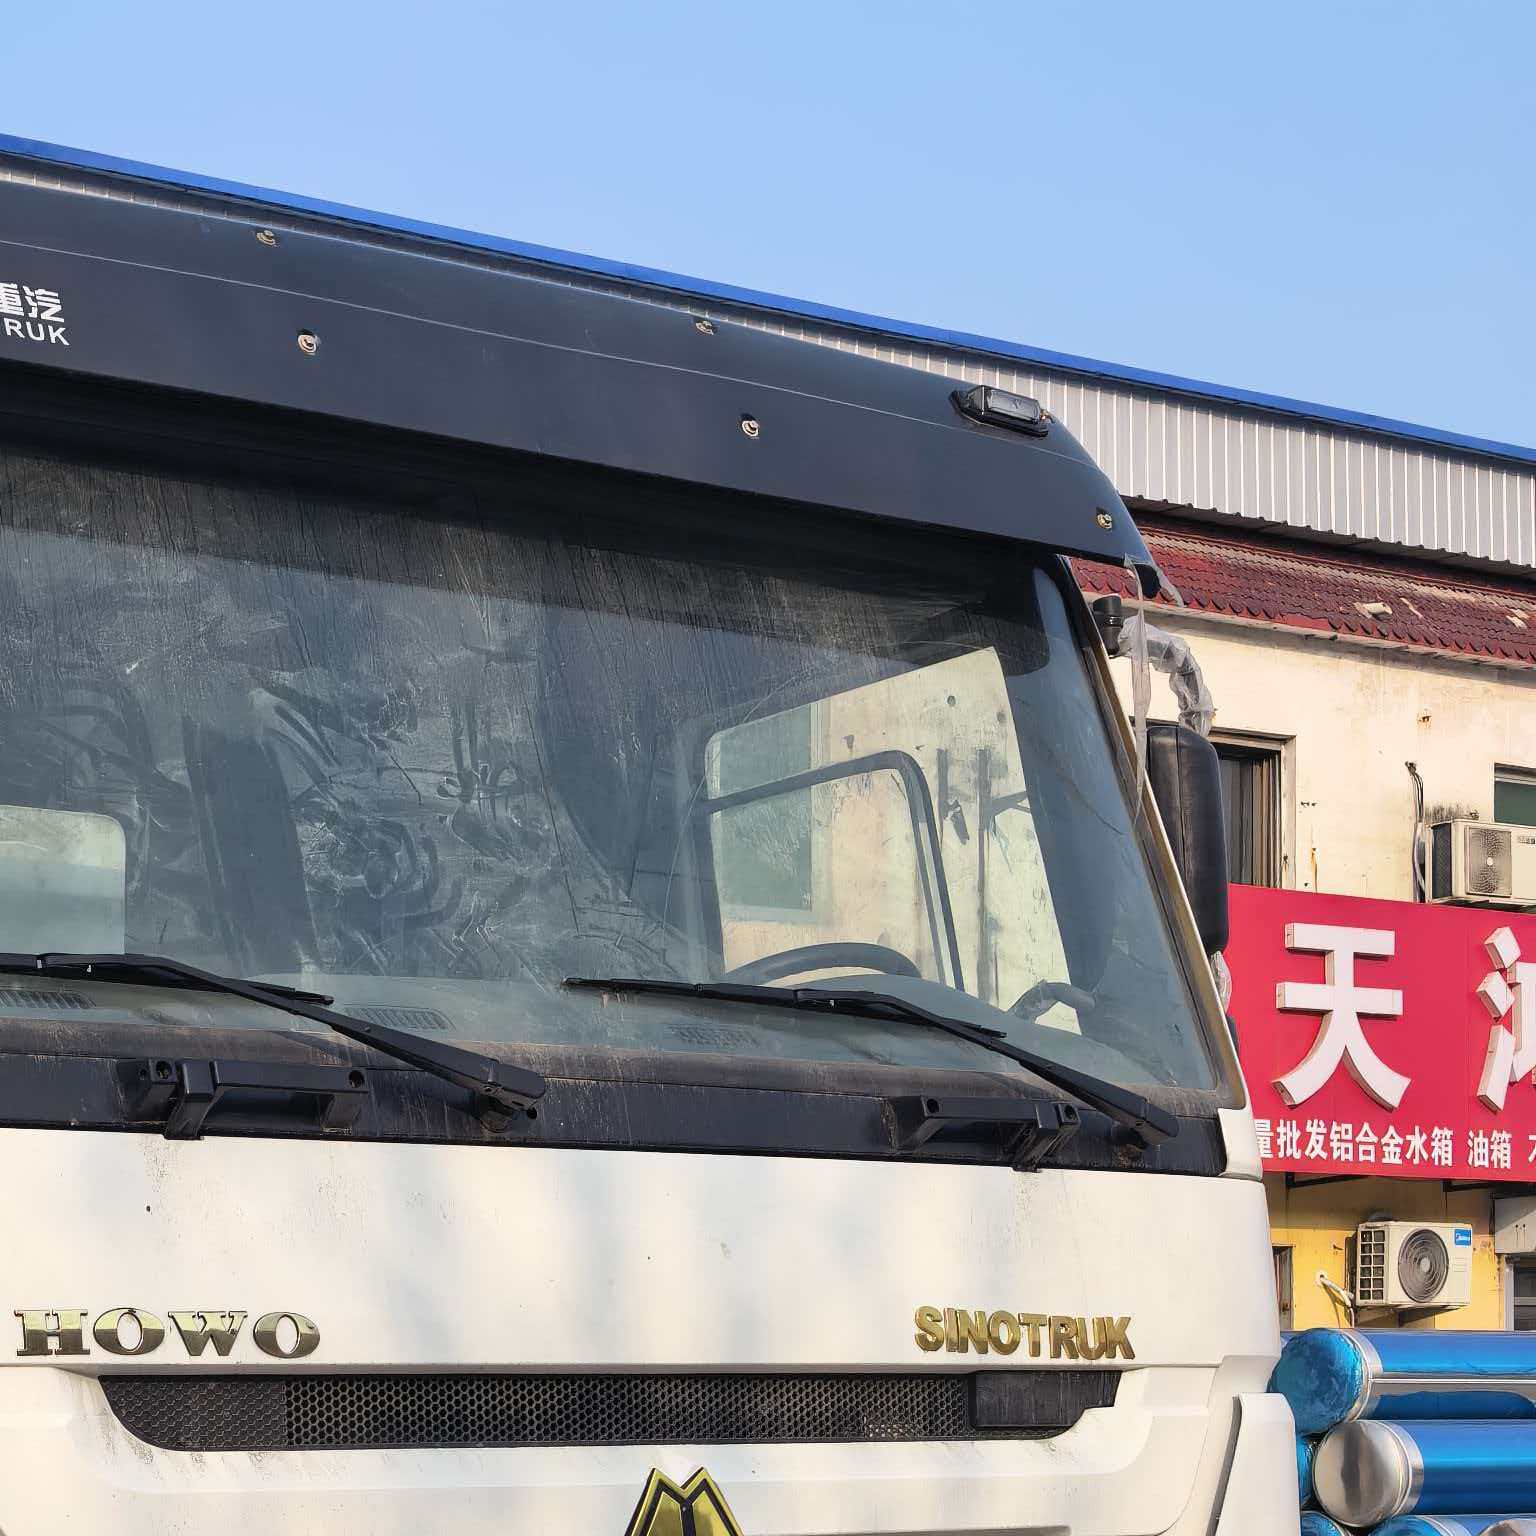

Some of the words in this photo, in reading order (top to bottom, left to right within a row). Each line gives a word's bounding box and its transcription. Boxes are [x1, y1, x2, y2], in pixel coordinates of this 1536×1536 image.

[1467, 1129, 1512, 1170] 油箱
[14, 1307, 321, 1359] HOWO
[914, 1305, 1136, 1360] SINOTRUK
